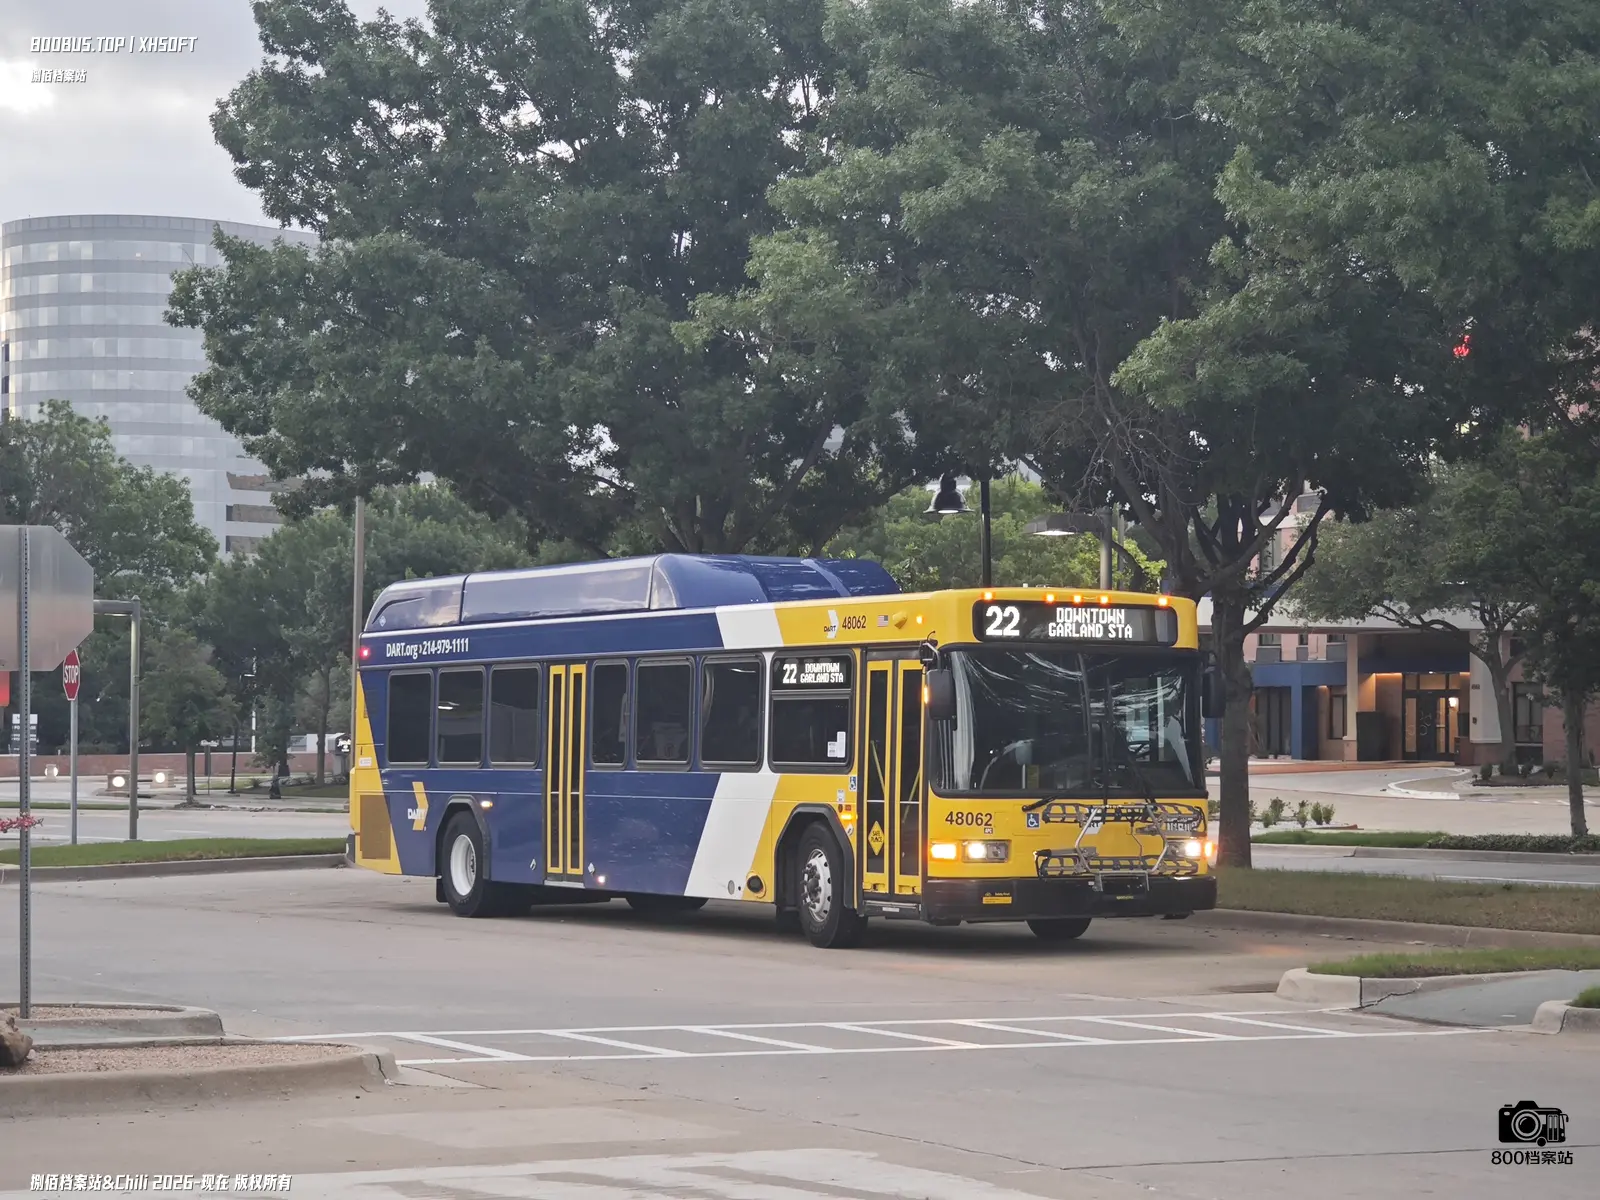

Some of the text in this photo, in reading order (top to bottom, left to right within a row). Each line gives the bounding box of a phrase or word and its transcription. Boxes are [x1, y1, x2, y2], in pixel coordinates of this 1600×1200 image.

[841, 615, 867, 630] 48062
[985, 605, 1020, 636] 22
[1056, 607, 1125, 624] DOWNTOWN
[1048, 622, 1133, 639] GARLAND STA
[422, 637, 469, 655] 214-979-1111
[64, 665, 79, 683] STOP
[782, 663, 798, 684] 22
[804, 662, 840, 673] DOWNTOWN
[800, 672, 844, 684] GARLAND STA
[945, 811, 993, 826] 48062
